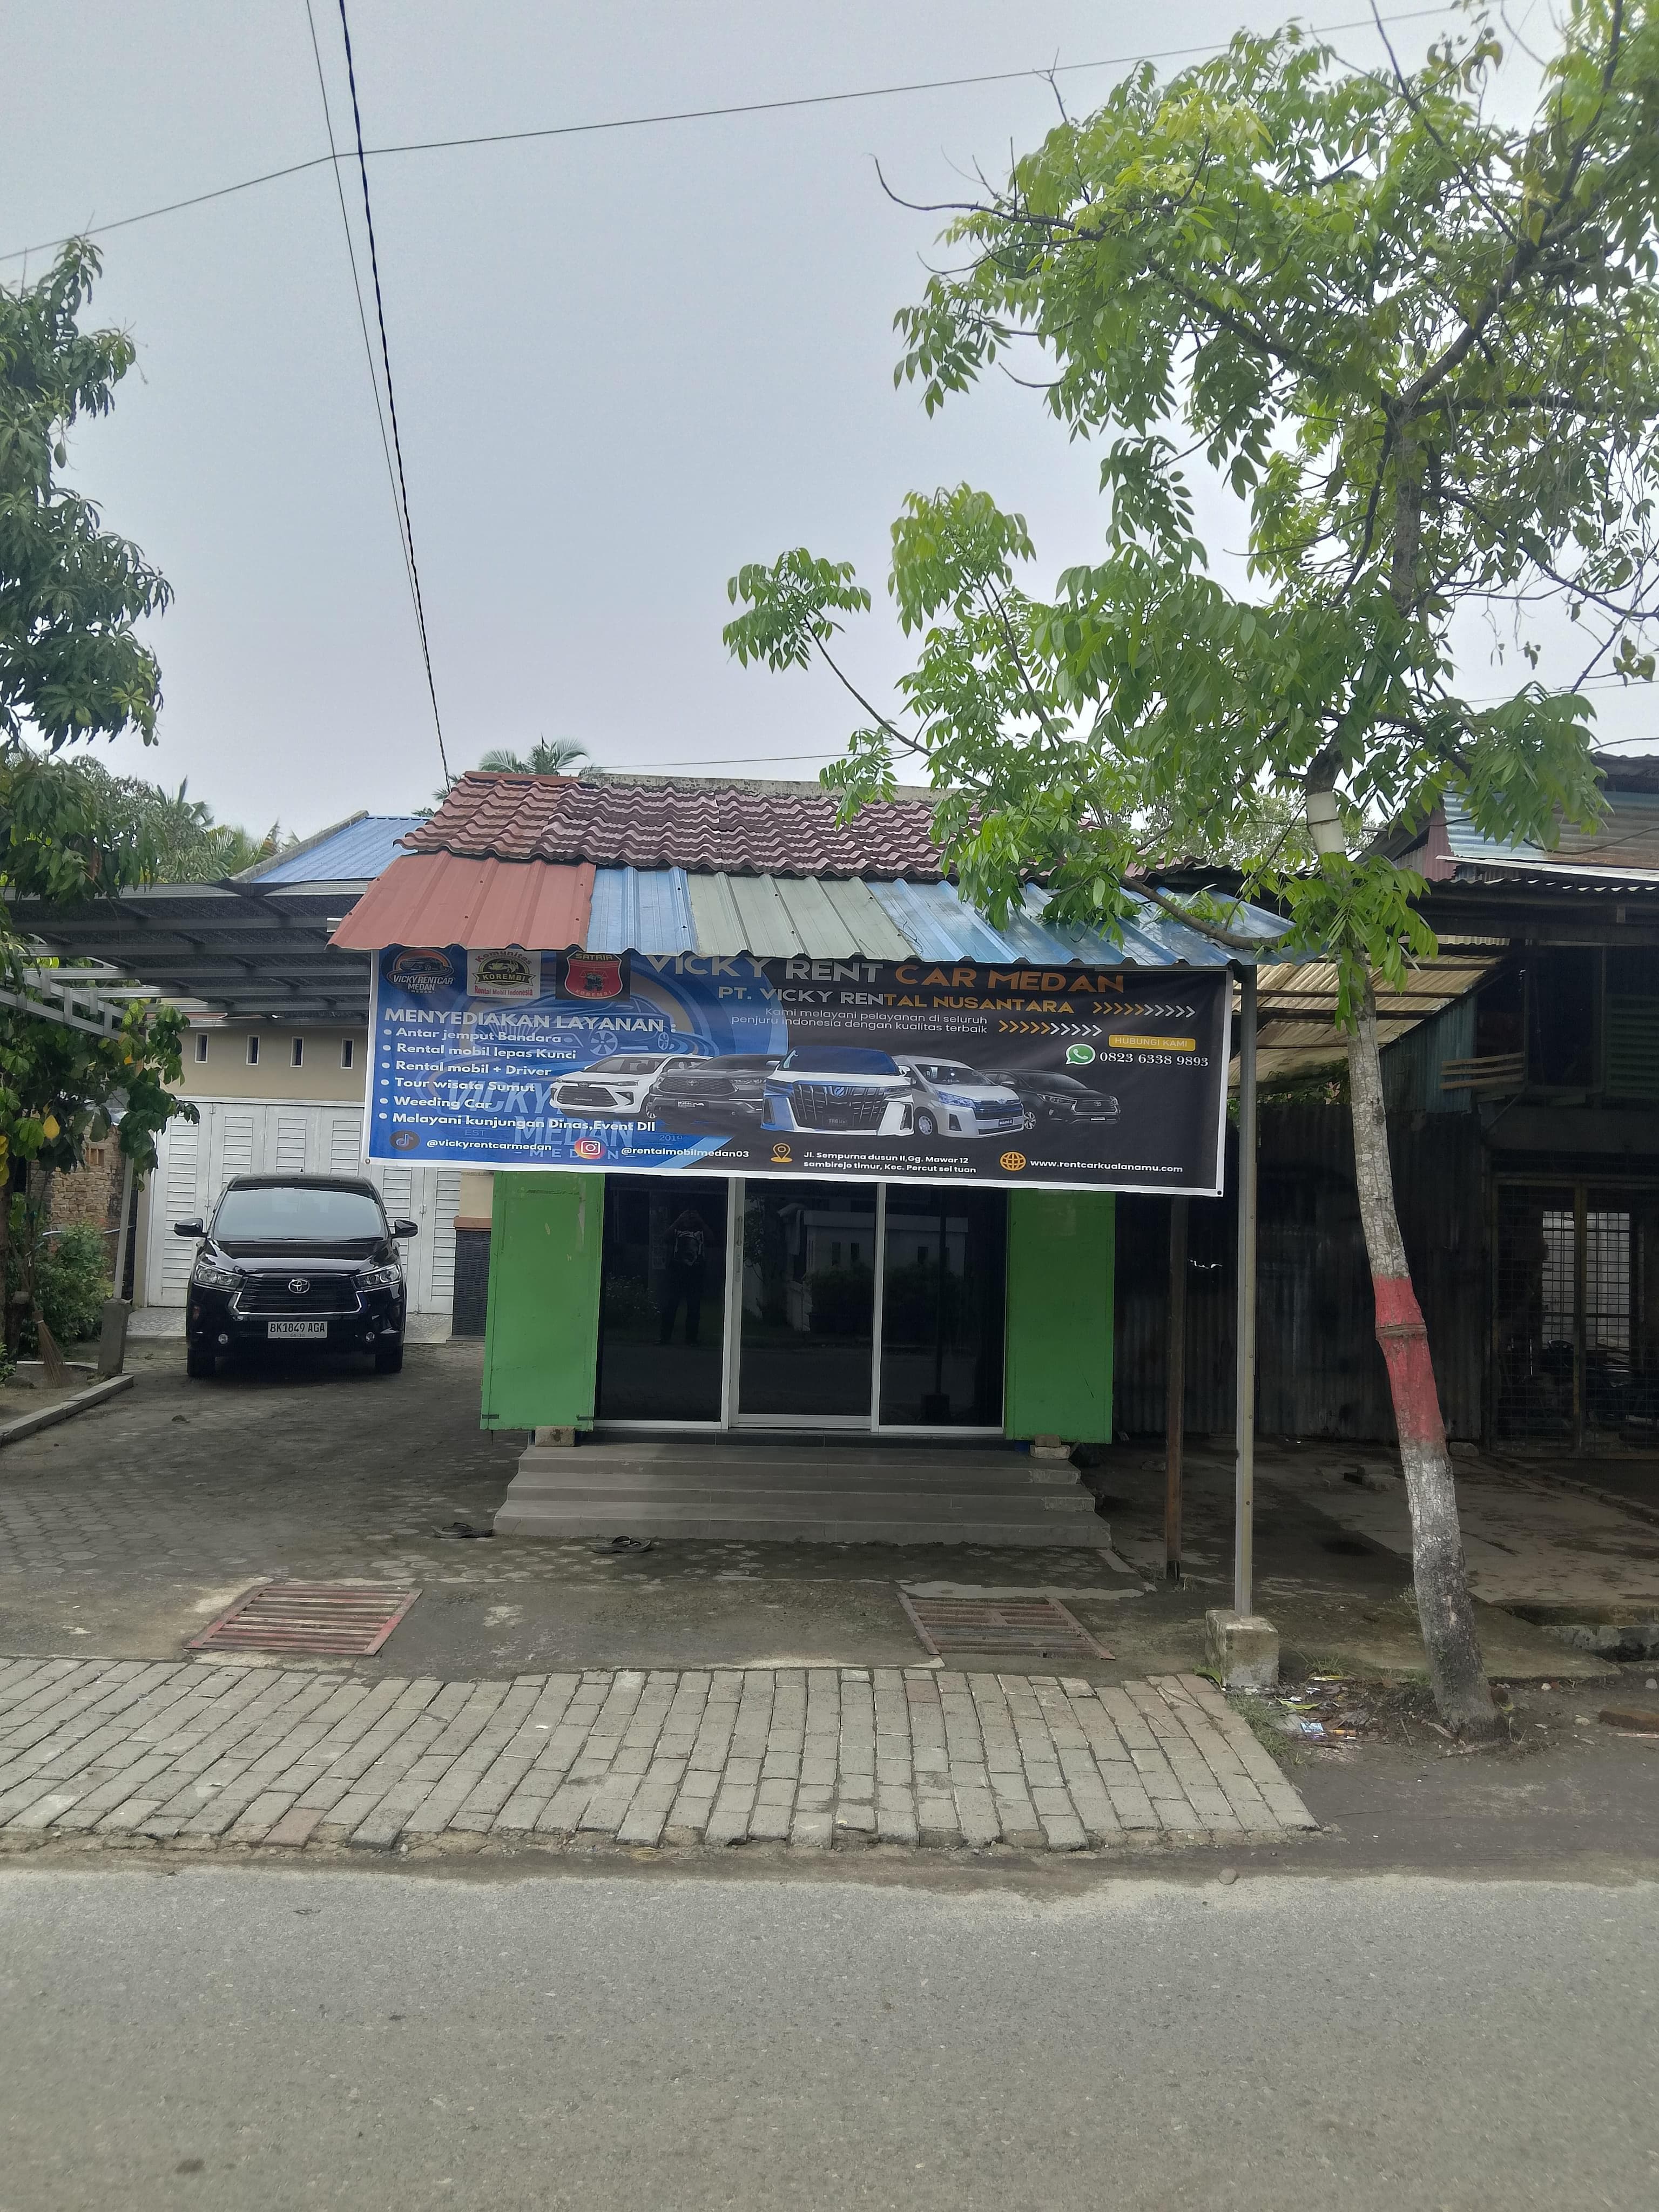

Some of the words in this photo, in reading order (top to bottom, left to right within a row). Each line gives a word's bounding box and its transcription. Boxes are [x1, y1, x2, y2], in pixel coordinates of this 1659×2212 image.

[475, 951, 532, 965] Komunitas
[646, 955, 773, 977] VICKY
[785, 959, 884, 983] RENT
[895, 965, 976, 988] CAR
[988, 969, 1124, 993] MEDAN
[474, 984, 491, 994] Rental
[718, 986, 752, 1000] PT.
[760, 988, 833, 1003] VICKY
[840, 992, 927, 1007] RENTAL
[933, 996, 1075, 1014] NUSANTARA
[385, 1008, 550, 1028] MENYEDIAKAN
[556, 1015, 664, 1032] LAYANAN
[766, 1008, 796, 1016] Kami
[800, 1009, 857, 1020] melayani
[860, 1011, 925, 1022] pelayanan
[943, 1015, 988, 1024] seluruh
[732, 1016, 778, 1025] penjuru
[782, 1017, 841, 1027] indonesia
[845, 1020, 892, 1031] dengan
[895, 1022, 942, 1031] kualitas
[946, 1024, 988, 1034] terbaik
[395, 1027, 440, 1038] Antar
[441, 1029, 495, 1042] jemput
[498, 1031, 561, 1043] Bandara
[1115, 1036, 1160, 1046] HUBUNGI
[1163, 1039, 1188, 1047] KAMI
[397, 1043, 444, 1054] Rental
[449, 1046, 490, 1056] mobil
[494, 1047, 532, 1059] lepas
[536, 1049, 576, 1059] Kunci
[1100, 1052, 1134, 1063] 0823
[1138, 1054, 1172, 1064] 6338
[1176, 1056, 1209, 1067] 9893
[396, 1060, 444, 1071] Rental
[448, 1063, 489, 1074] mobil
[506, 1065, 552, 1075] Driver
[395, 1077, 430, 1088] Tour
[433, 1079, 484, 1090] wisata
[487, 1081, 535, 1092] Sumut
[394, 1096, 460, 1110] Weeding
[464, 1099, 493, 1109] Car
[392, 1112, 462, 1125] Melayani
[466, 1115, 545, 1129] kunjungan
[637, 1122, 656, 1132] Dll
[426, 1139, 552, 1151] @vickyrentcarmedan
[529, 1148, 619, 1160] MEDN
[621, 1147, 750, 1158] @rentalmobilmedan03
[816, 1151, 866, 1162] Sempurna
[868, 1153, 898, 1161] dusun
[804, 1161, 852, 1170] sambirejo
[853, 1162, 882, 1171] timur,
[906, 1164, 938, 1172] Percut
[1030, 1159, 1183, 1172] www.rentcarkualanamu.com
[307, 1323, 325, 1332] AGA
